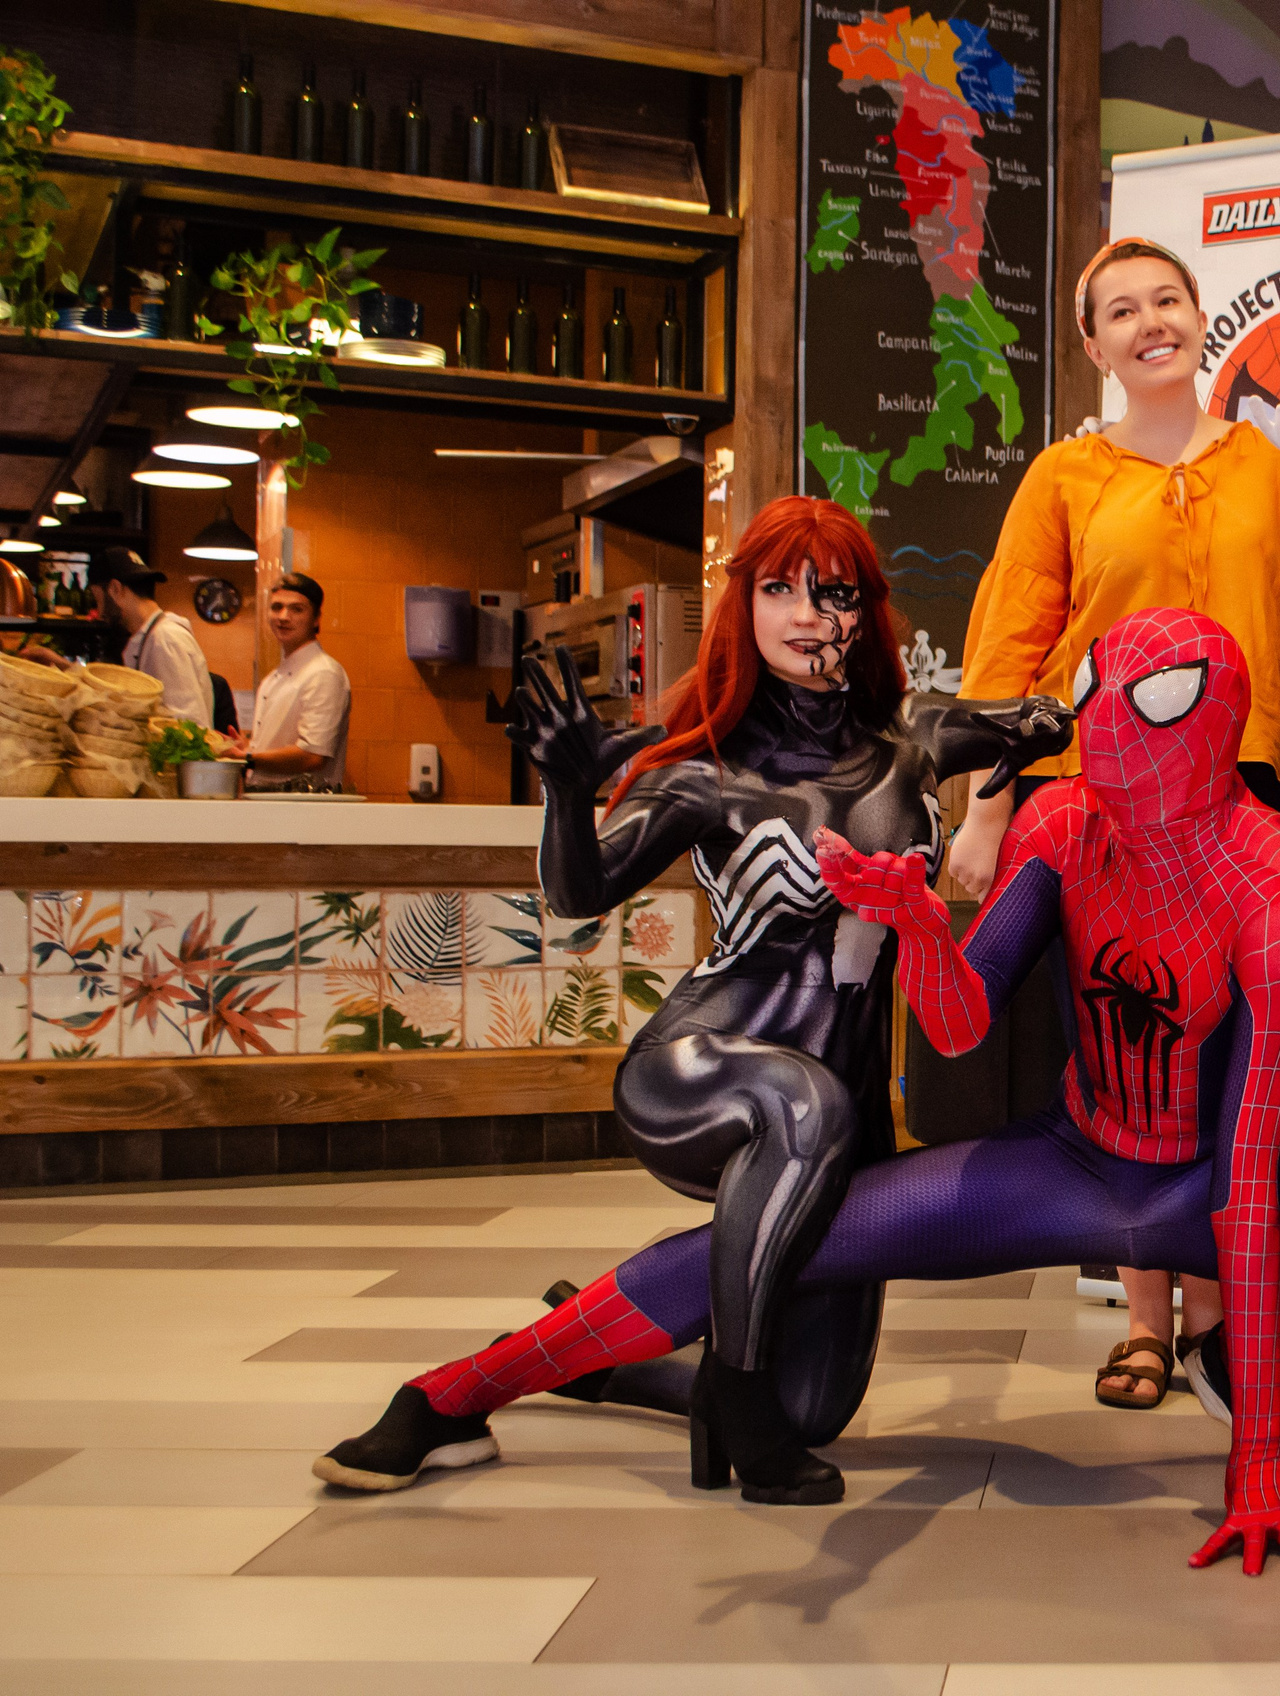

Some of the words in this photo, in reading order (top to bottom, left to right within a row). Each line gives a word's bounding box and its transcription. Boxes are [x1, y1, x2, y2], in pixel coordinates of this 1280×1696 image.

[856, 100, 900, 122] Liguria
[819, 158, 869, 178] Tuscany
[868, 182, 913, 201] Umbria
[860, 240, 919, 270] Sardegna
[877, 331, 942, 354] Campania
[877, 392, 940, 413] Basilicata
[985, 444, 1025, 468] Puglia
[945, 466, 1000, 485] Calabria
